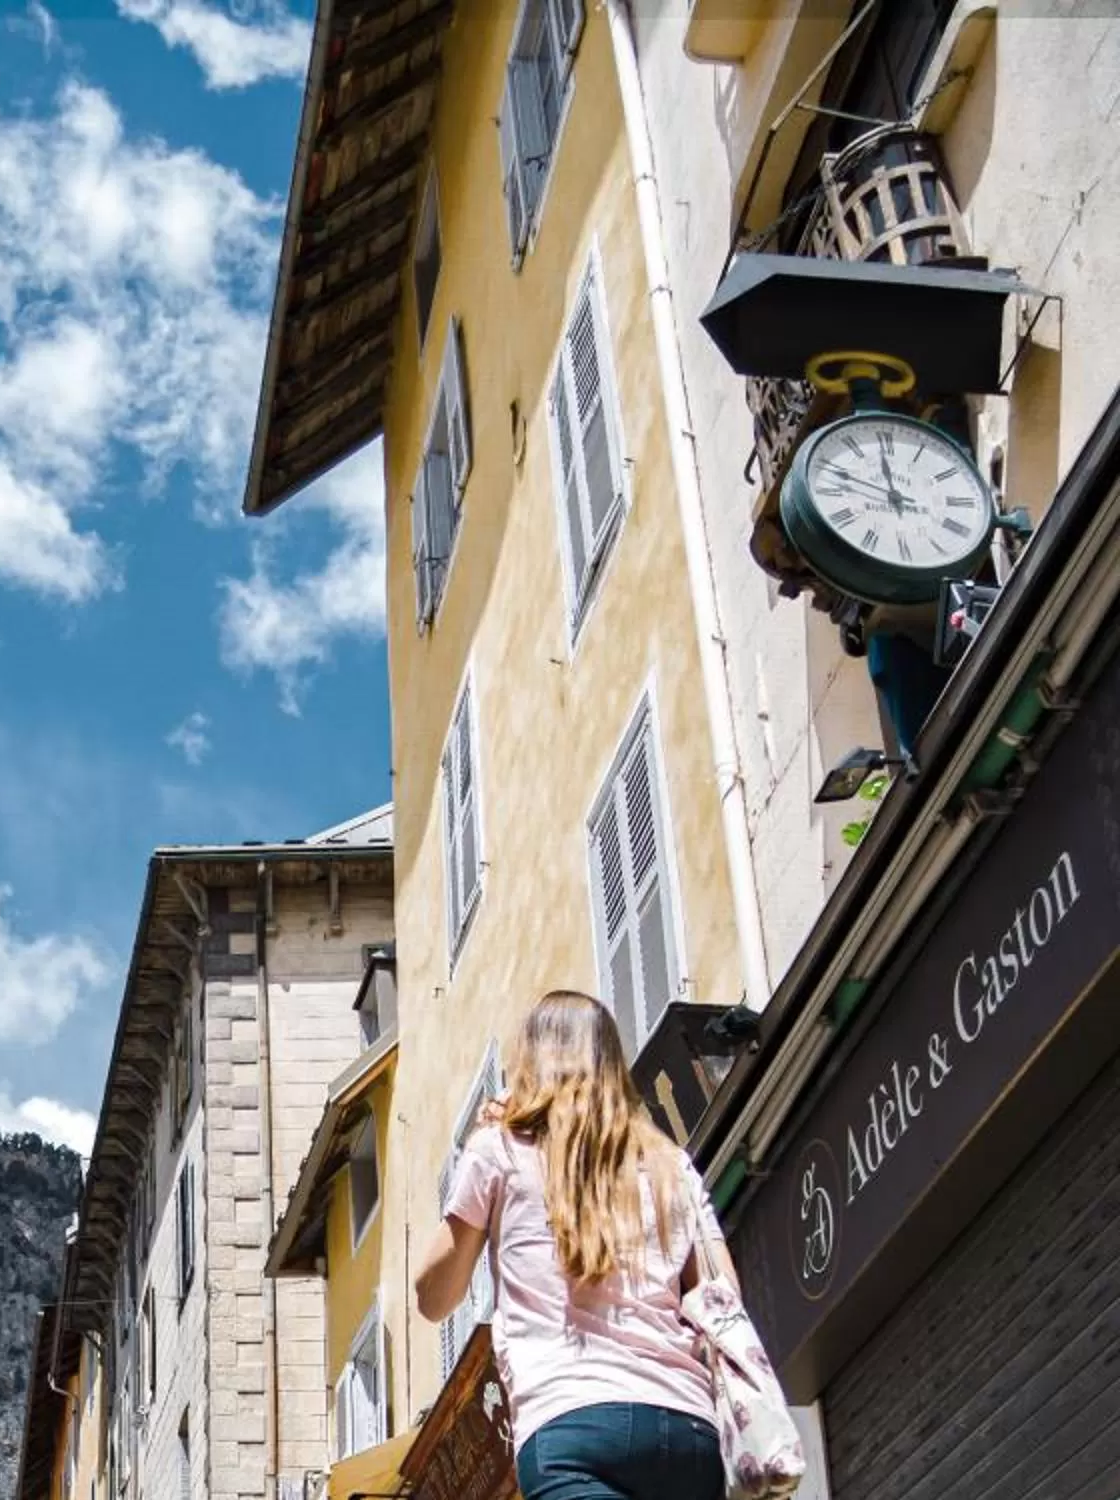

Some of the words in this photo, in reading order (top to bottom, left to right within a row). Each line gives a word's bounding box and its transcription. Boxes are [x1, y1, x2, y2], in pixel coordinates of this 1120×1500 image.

[847, 1062, 923, 1205] Adèle
[928, 1033, 953, 1090] &
[953, 851, 1081, 1044] Gaston
